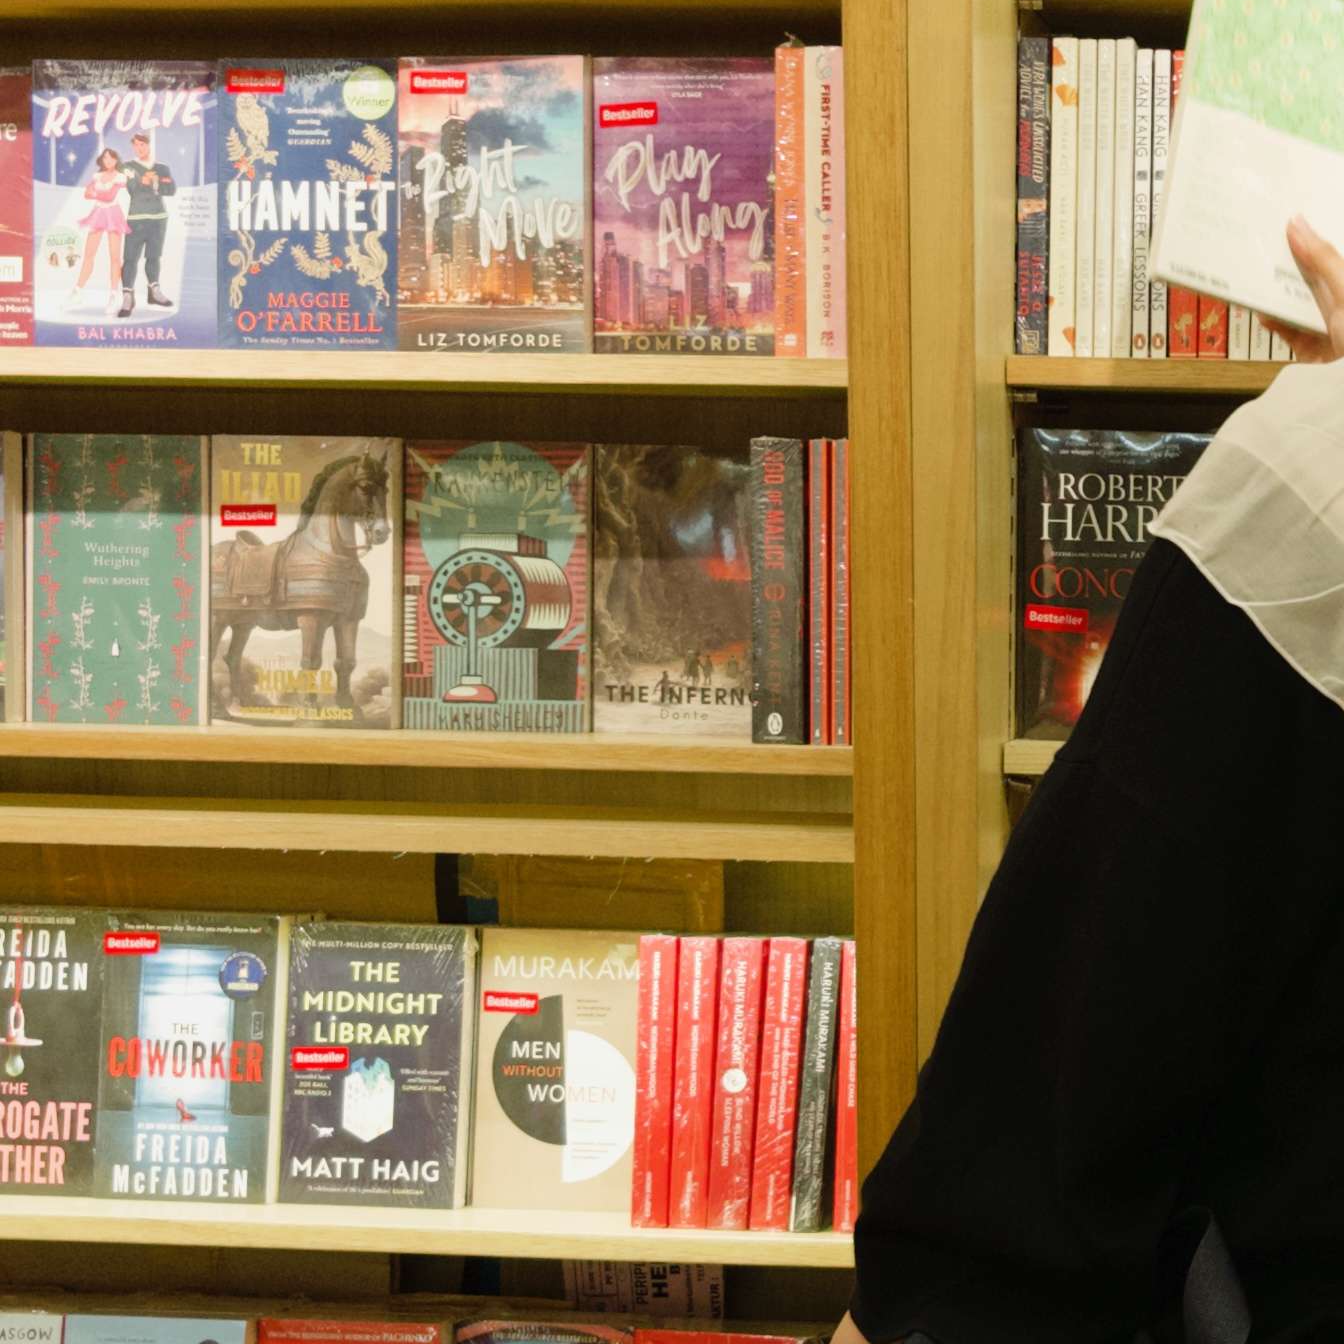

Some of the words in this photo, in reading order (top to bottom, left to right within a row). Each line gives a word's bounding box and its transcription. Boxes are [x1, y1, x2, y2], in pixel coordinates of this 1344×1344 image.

[42, 90, 204, 137] REVOLVE
[228, 181, 396, 232] HAMNET
[1135, 193, 1147, 238] GREEK
[1132, 246, 1146, 312] LESSONS
[266, 292, 351, 310] MAGGIE
[77, 327, 108, 341] BAL
[112, 327, 178, 341] KHABRA
[236, 311, 384, 334] O'FARRELL
[417, 333, 449, 347] LIZ
[457, 332, 563, 347] TOMFORDE
[1058, 472, 1189, 502] ROBERT
[83, 542, 150, 557] Wuthering
[92, 556, 142, 569] Heights
[659, 708, 709, 721] Dante
[493, 956, 640, 981] MURAKAM
[106, 1035, 265, 1083] COWORKER
[511, 1040, 561, 1060] MEN
[502, 1064, 563, 1078] WITHOUT
[527, 1084, 617, 1104] WOMEN
[135, 1133, 228, 1165] FREIDA
[112, 1164, 249, 1198] McFADDEN
[290, 1157, 365, 1181] MATT
[372, 1160, 441, 1182] HAIG
